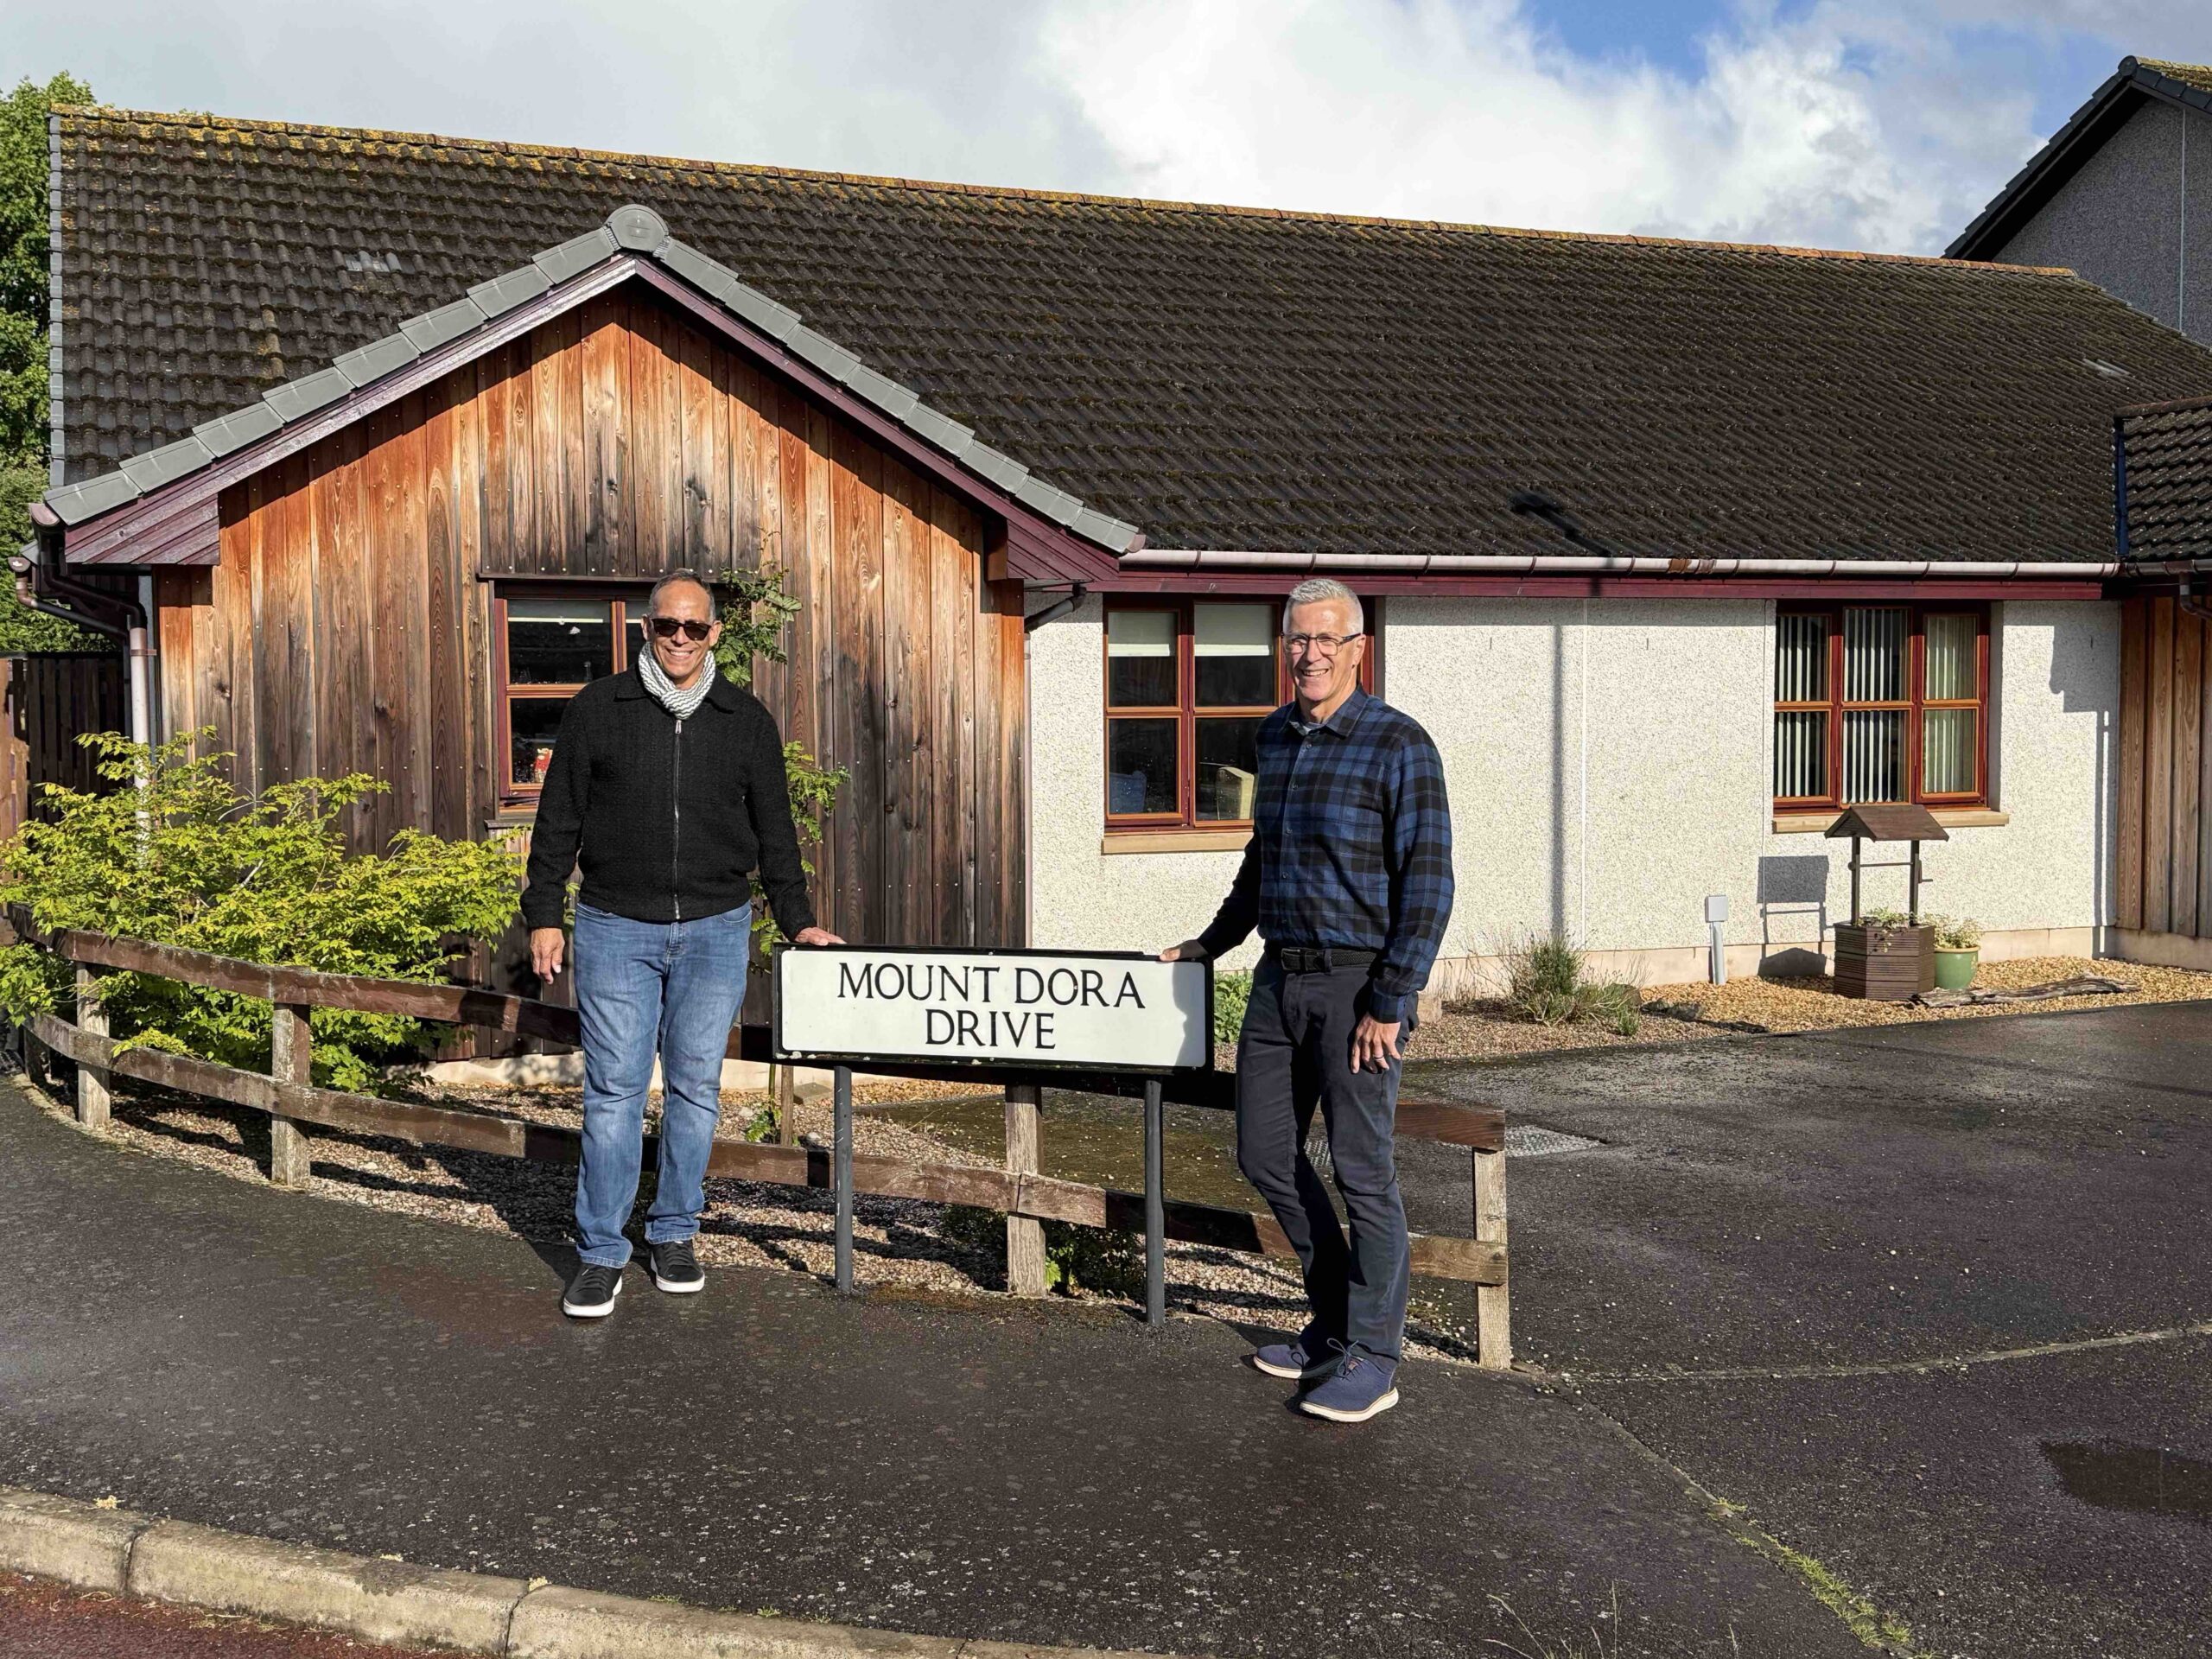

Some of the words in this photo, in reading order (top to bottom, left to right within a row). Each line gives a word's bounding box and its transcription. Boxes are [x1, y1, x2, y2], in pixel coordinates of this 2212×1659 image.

[837, 963, 1001, 1003] MOUNT
[1014, 967, 1146, 1009] DORA
[925, 1008, 1056, 1050] DRIVE
